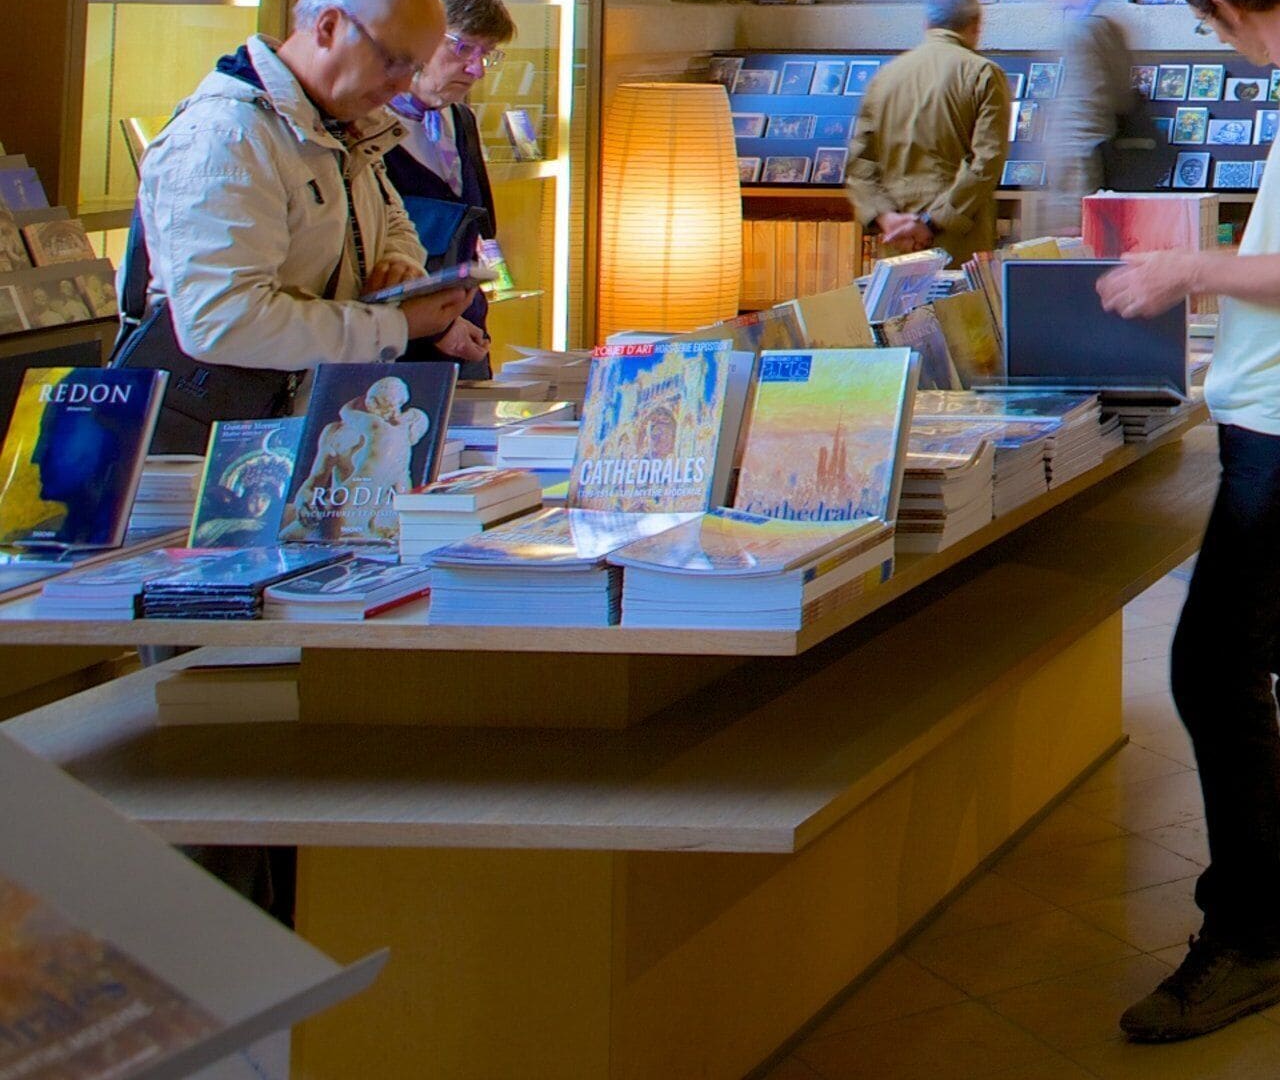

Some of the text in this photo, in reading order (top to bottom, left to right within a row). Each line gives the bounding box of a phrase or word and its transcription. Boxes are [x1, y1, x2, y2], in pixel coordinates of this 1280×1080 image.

[626, 344, 654, 355] D'ART
[38, 383, 133, 404] REDON
[580, 455, 706, 485] CATHÉDRALES
